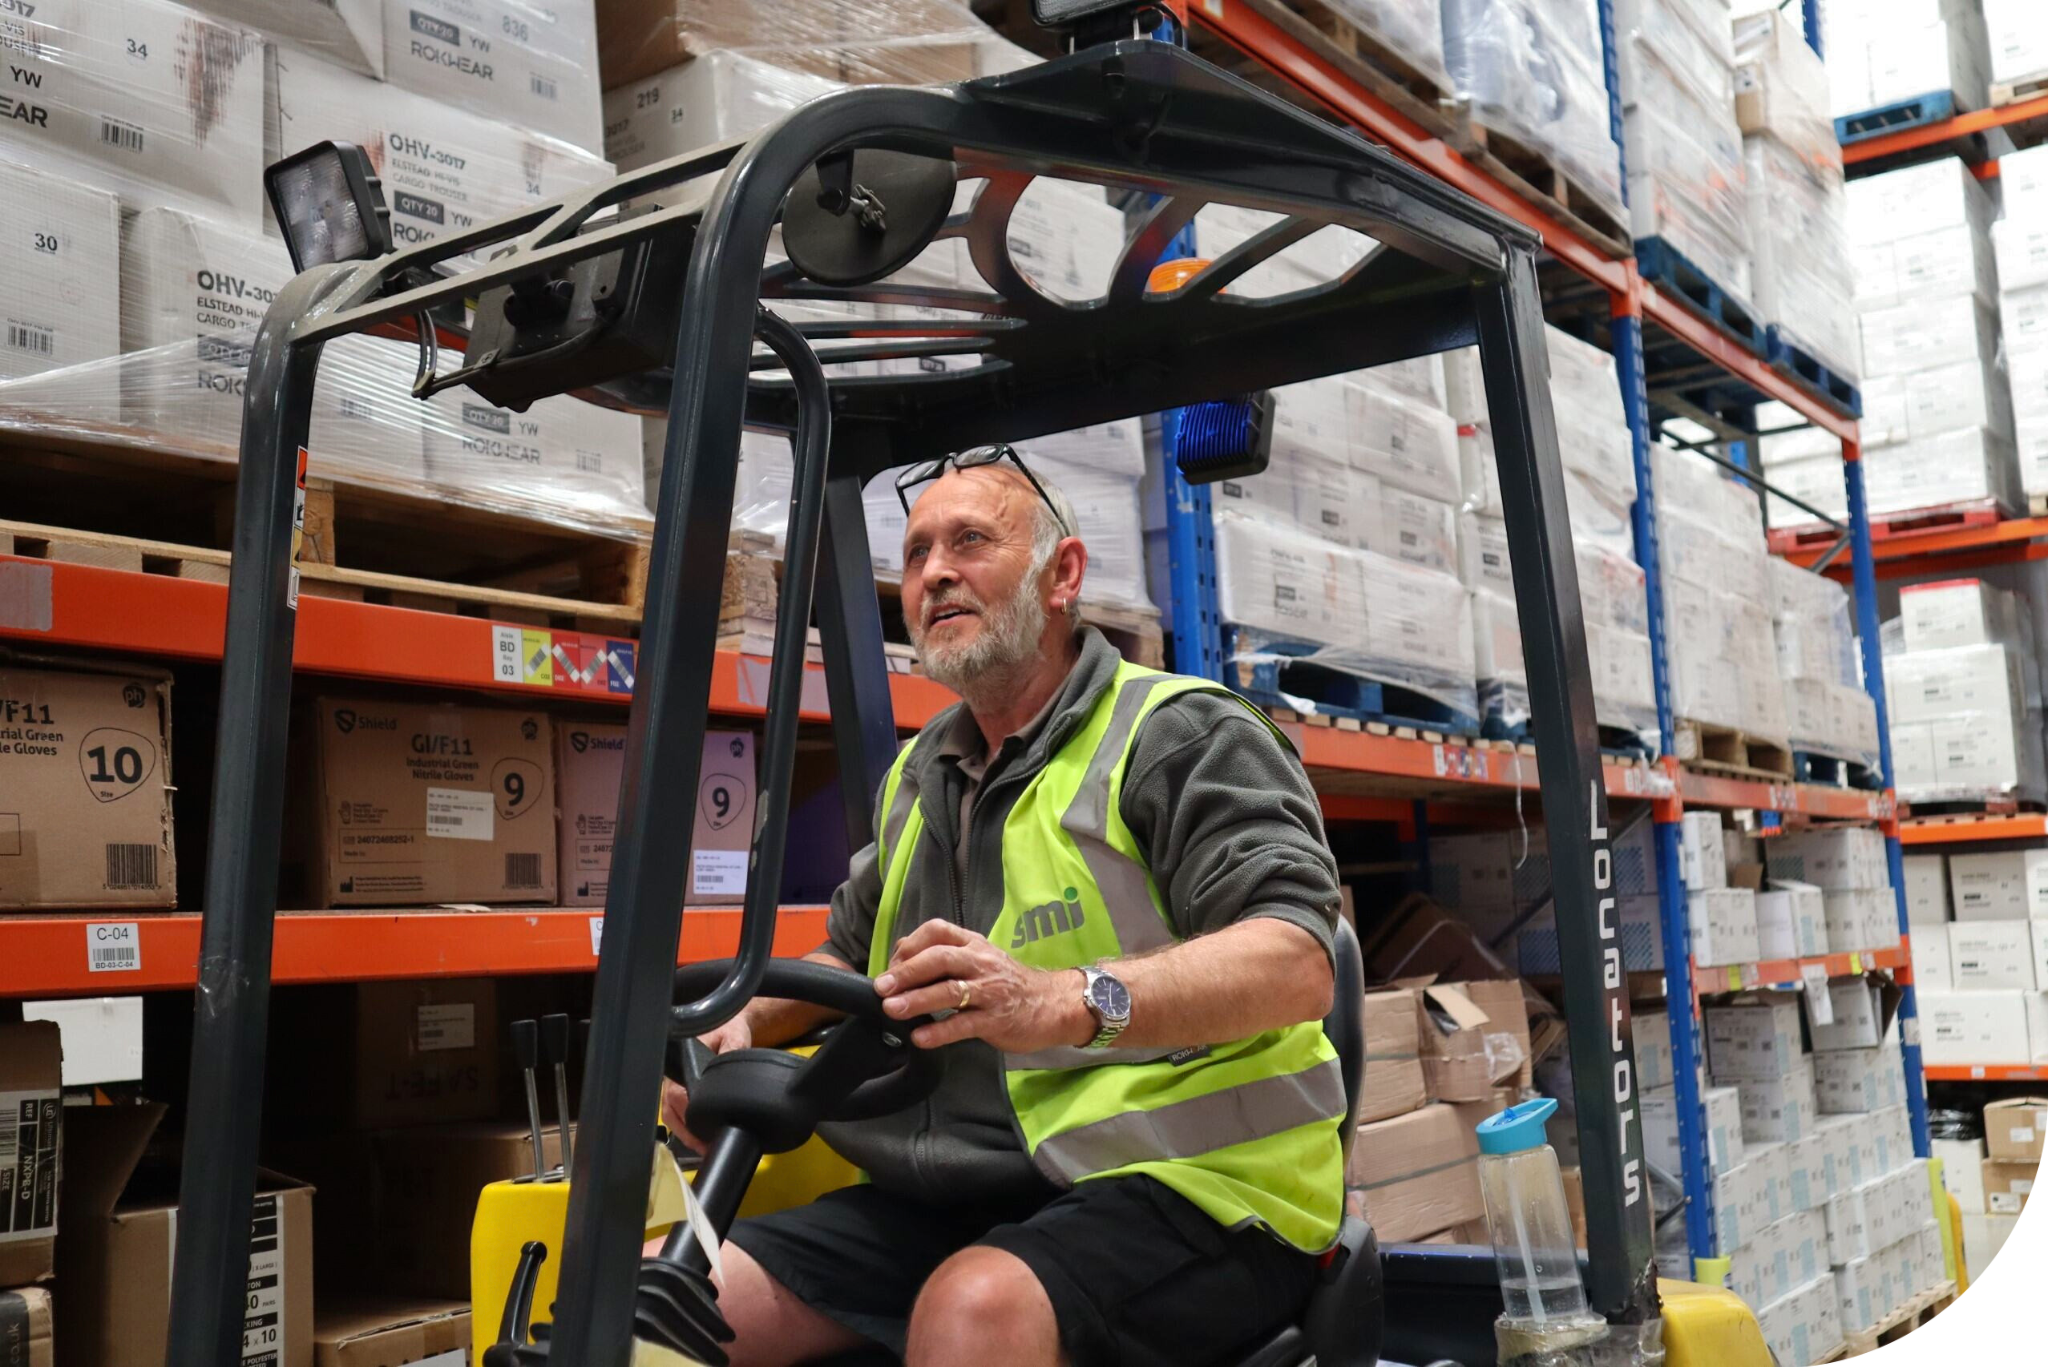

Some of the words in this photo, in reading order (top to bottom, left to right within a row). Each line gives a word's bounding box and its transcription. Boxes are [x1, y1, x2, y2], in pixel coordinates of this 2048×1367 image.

[127, 38, 148, 57] 34
[469, 35, 490, 53] YW
[10, 65, 42, 89] YW
[389, 133, 466, 170] OHV-3017
[392, 158, 431, 177] ELSTEAD
[392, 172, 426, 189] CARGO
[430, 182, 468, 201] TROUSER
[526, 181, 541, 195] 34
[401, 197, 423, 212] QTY
[426, 204, 438, 217] 20
[451, 211, 473, 228] YW
[34, 232, 58, 252] 30
[197, 296, 243, 316] ELSTEAD
[196, 312, 236, 330] CARGO
[469, 409, 489, 424] QTY
[518, 421, 539, 437] YW
[500, 641, 515, 653] BD
[502, 665, 514, 676] 03
[358, 717, 398, 731] Shield
[25, 729, 64, 742] Green
[411, 733, 475, 756] GI/F11
[590, 733, 624, 750] Shield
[14, 743, 57, 756] Gloves
[87, 745, 143, 784] 10
[406, 757, 450, 768] Industrial
[452, 759, 480, 770] Green
[412, 769, 442, 781] Nitrile
[444, 770, 475, 782] Gloves
[100, 791, 114, 799] Size
[504, 772, 524, 807] 9
[711, 786, 730, 818] 9
[1011, 886, 1085, 949] smi
[96, 927, 129, 941] C-04
[95, 961, 134, 969] BD-03-C-04
[1590, 779, 1641, 1208] Locators
[25, 1102, 34, 1119] REF
[2, 1171, 11, 1192] SIZE
[244, 1317, 263, 1329] KING
[261, 1328, 276, 1344] 10
